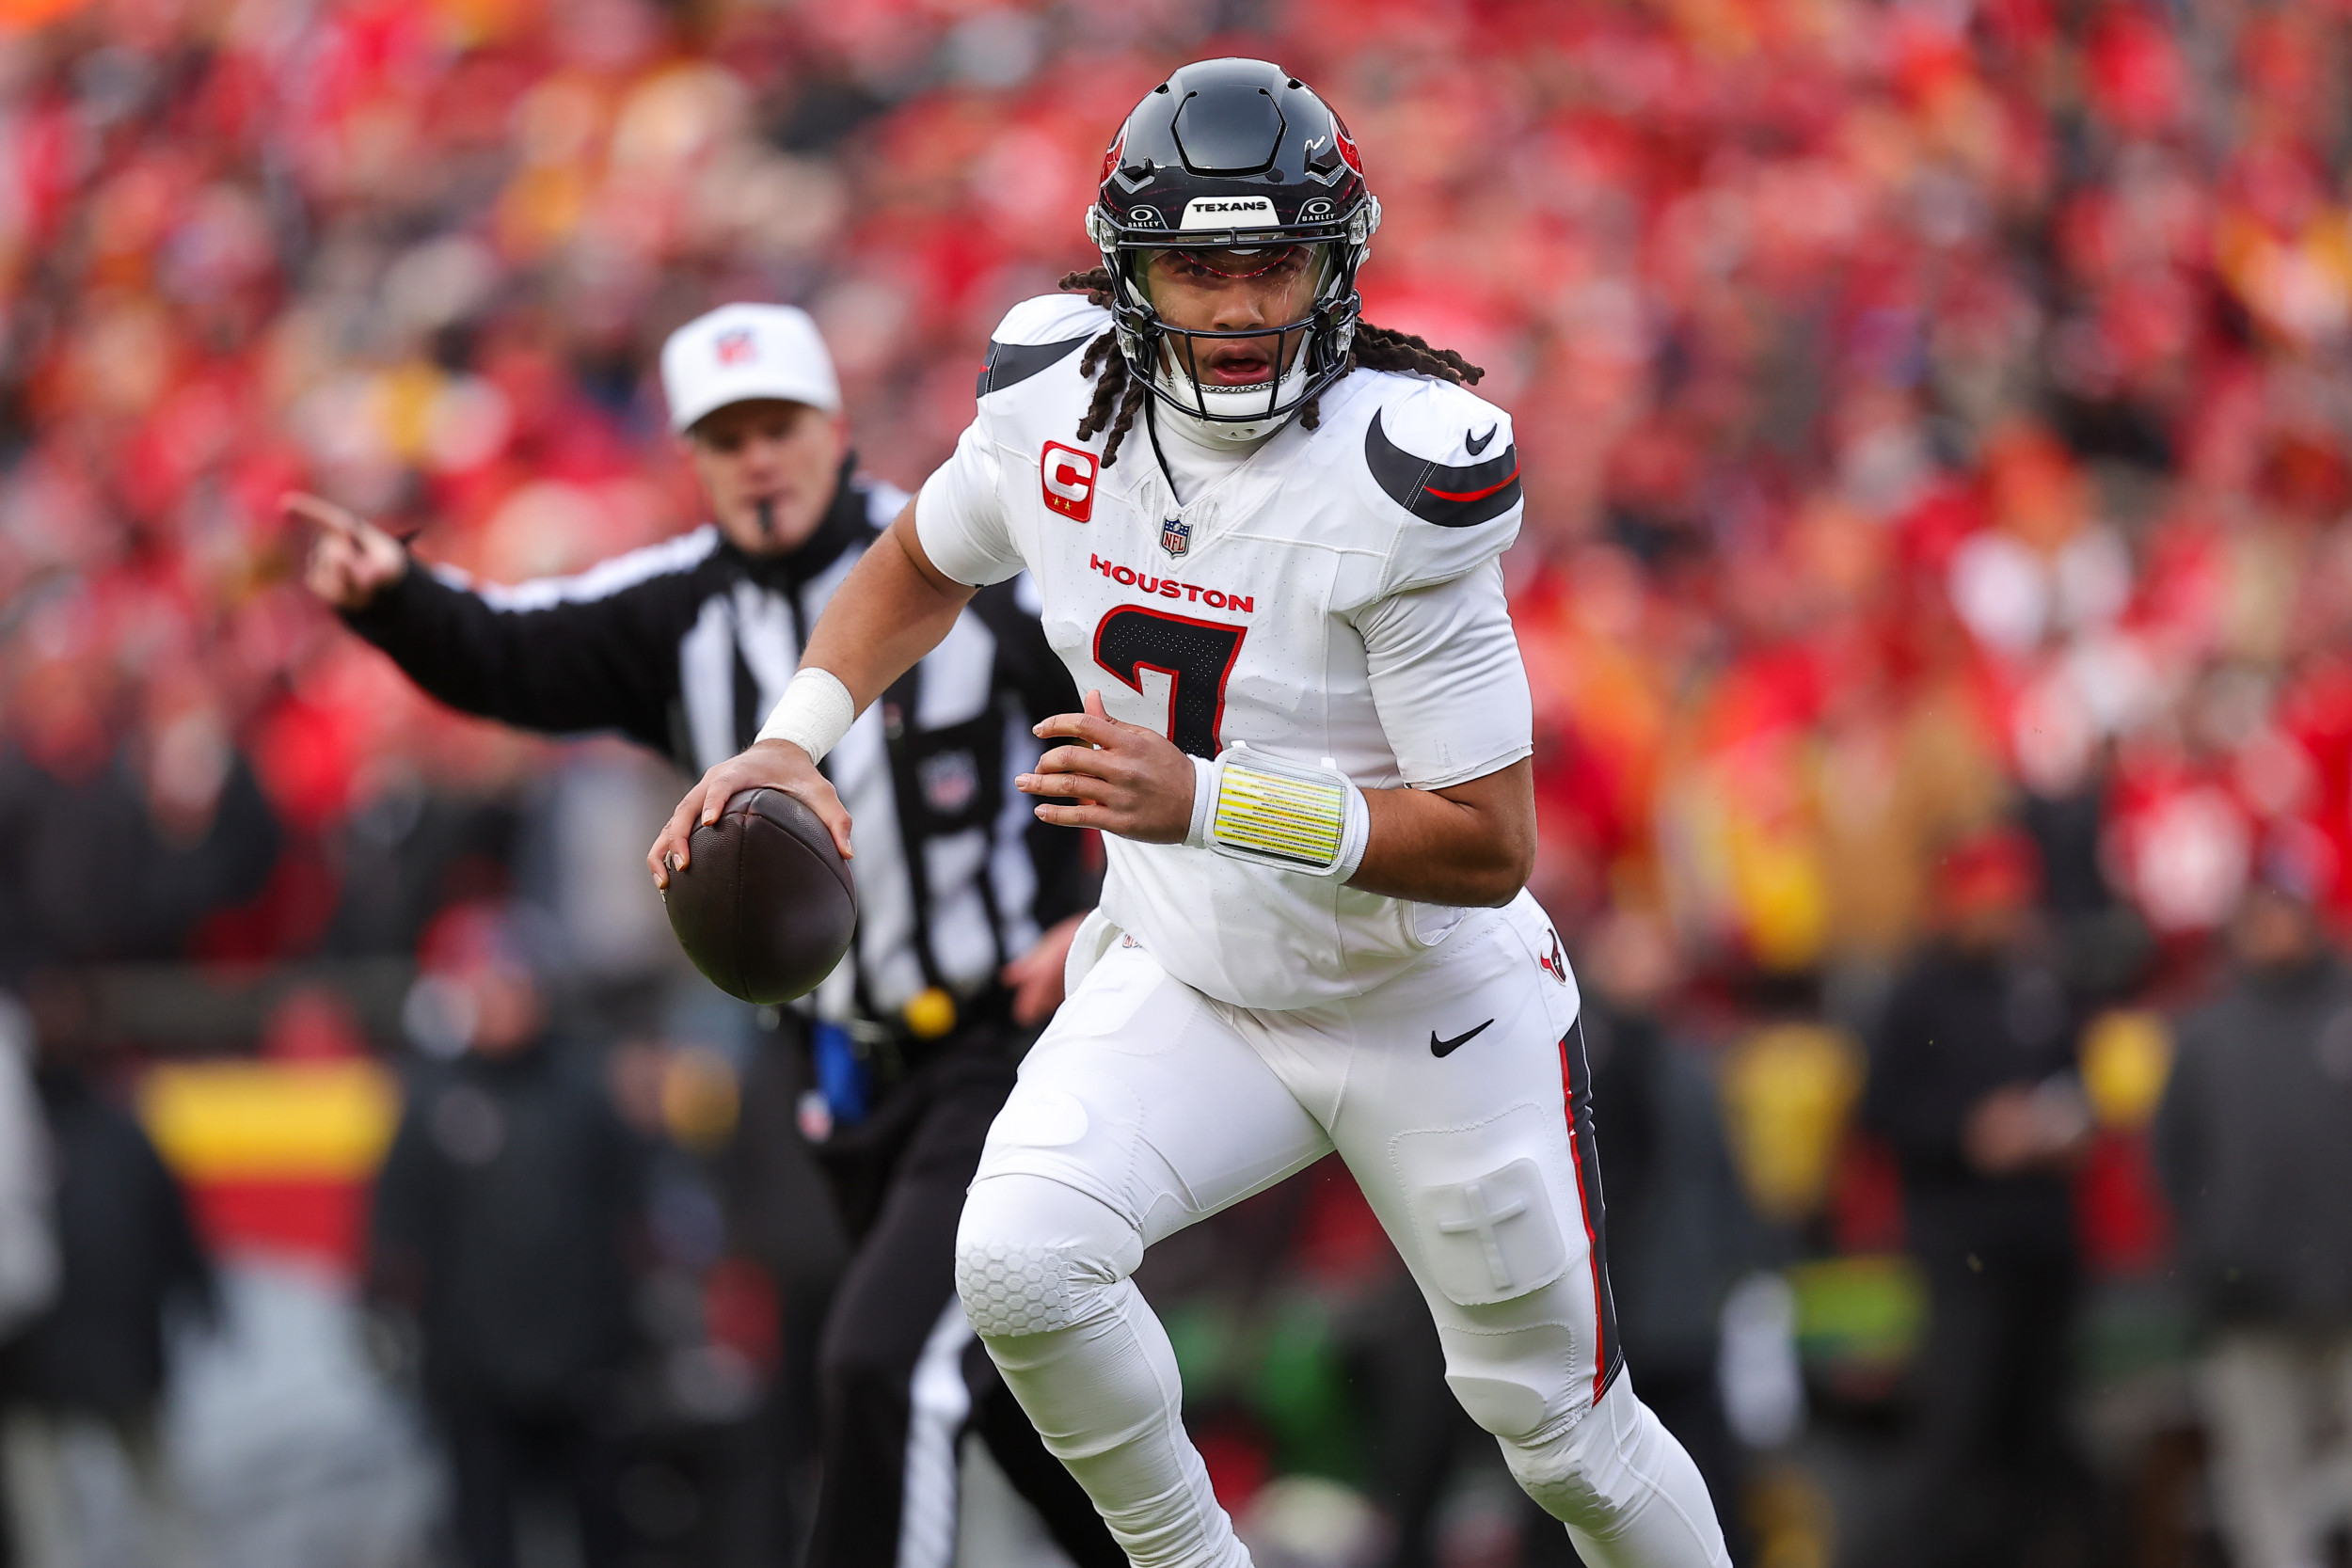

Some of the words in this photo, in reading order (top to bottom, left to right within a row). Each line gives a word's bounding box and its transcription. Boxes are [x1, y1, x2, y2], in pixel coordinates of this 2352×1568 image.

[1192, 200, 1267, 213] TEXANS
[1302, 213, 1335, 222] OAKLEY
[1043, 447, 1092, 503] C
[1163, 531, 1184, 552] NFL
[1089, 552, 1254, 613] HOUSTON
[1093, 604, 1248, 762] 7
